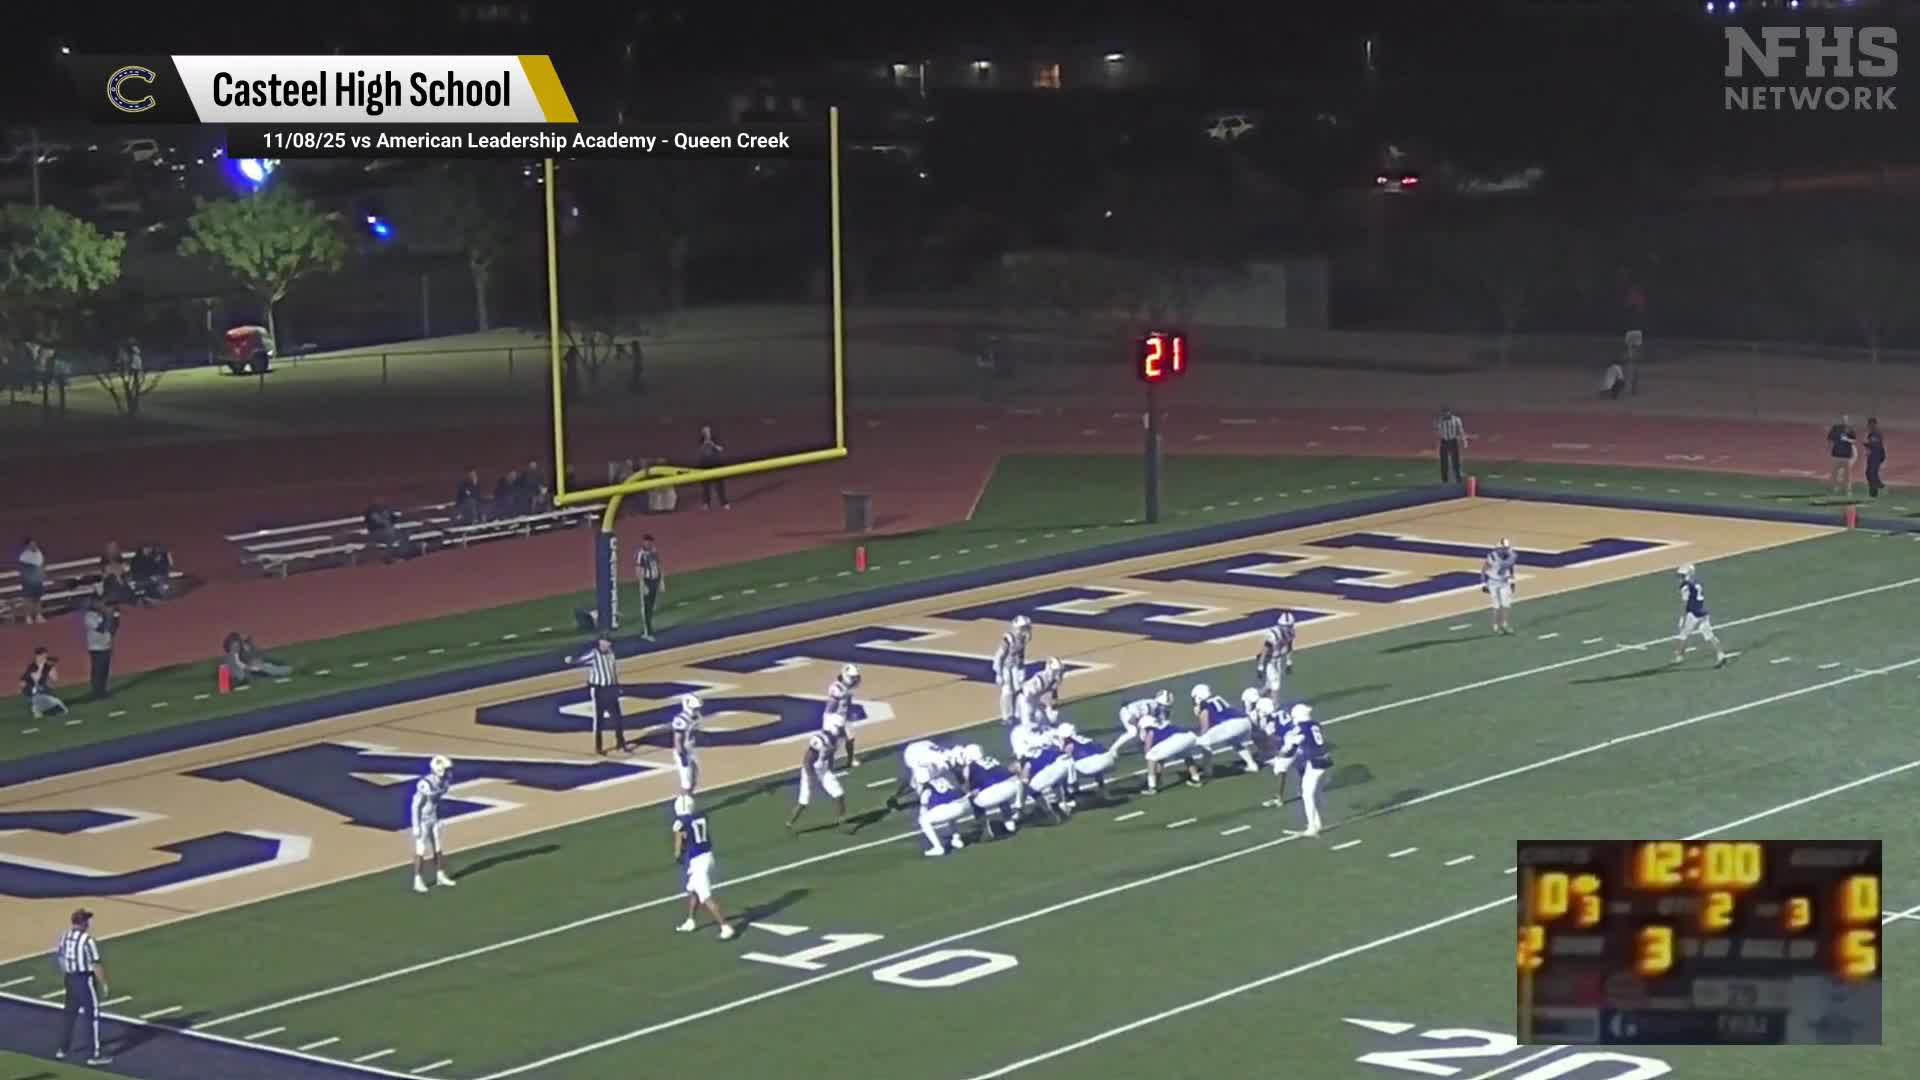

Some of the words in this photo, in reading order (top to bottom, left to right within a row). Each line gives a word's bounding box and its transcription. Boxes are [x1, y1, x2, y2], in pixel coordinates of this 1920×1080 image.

[1145, 336, 1181, 377] 21
[691, 818, 706, 844] 17
[1642, 841, 1761, 885] 12:00
[1538, 872, 1569, 915] 0
[1578, 895, 1601, 925] 3
[1703, 891, 1733, 928] 2
[1787, 897, 1811, 928] 3
[1846, 875, 1879, 919] 0
[740, 932, 1019, 988] 10
[1640, 925, 1674, 974] 3
[1843, 929, 1877, 975] 5
